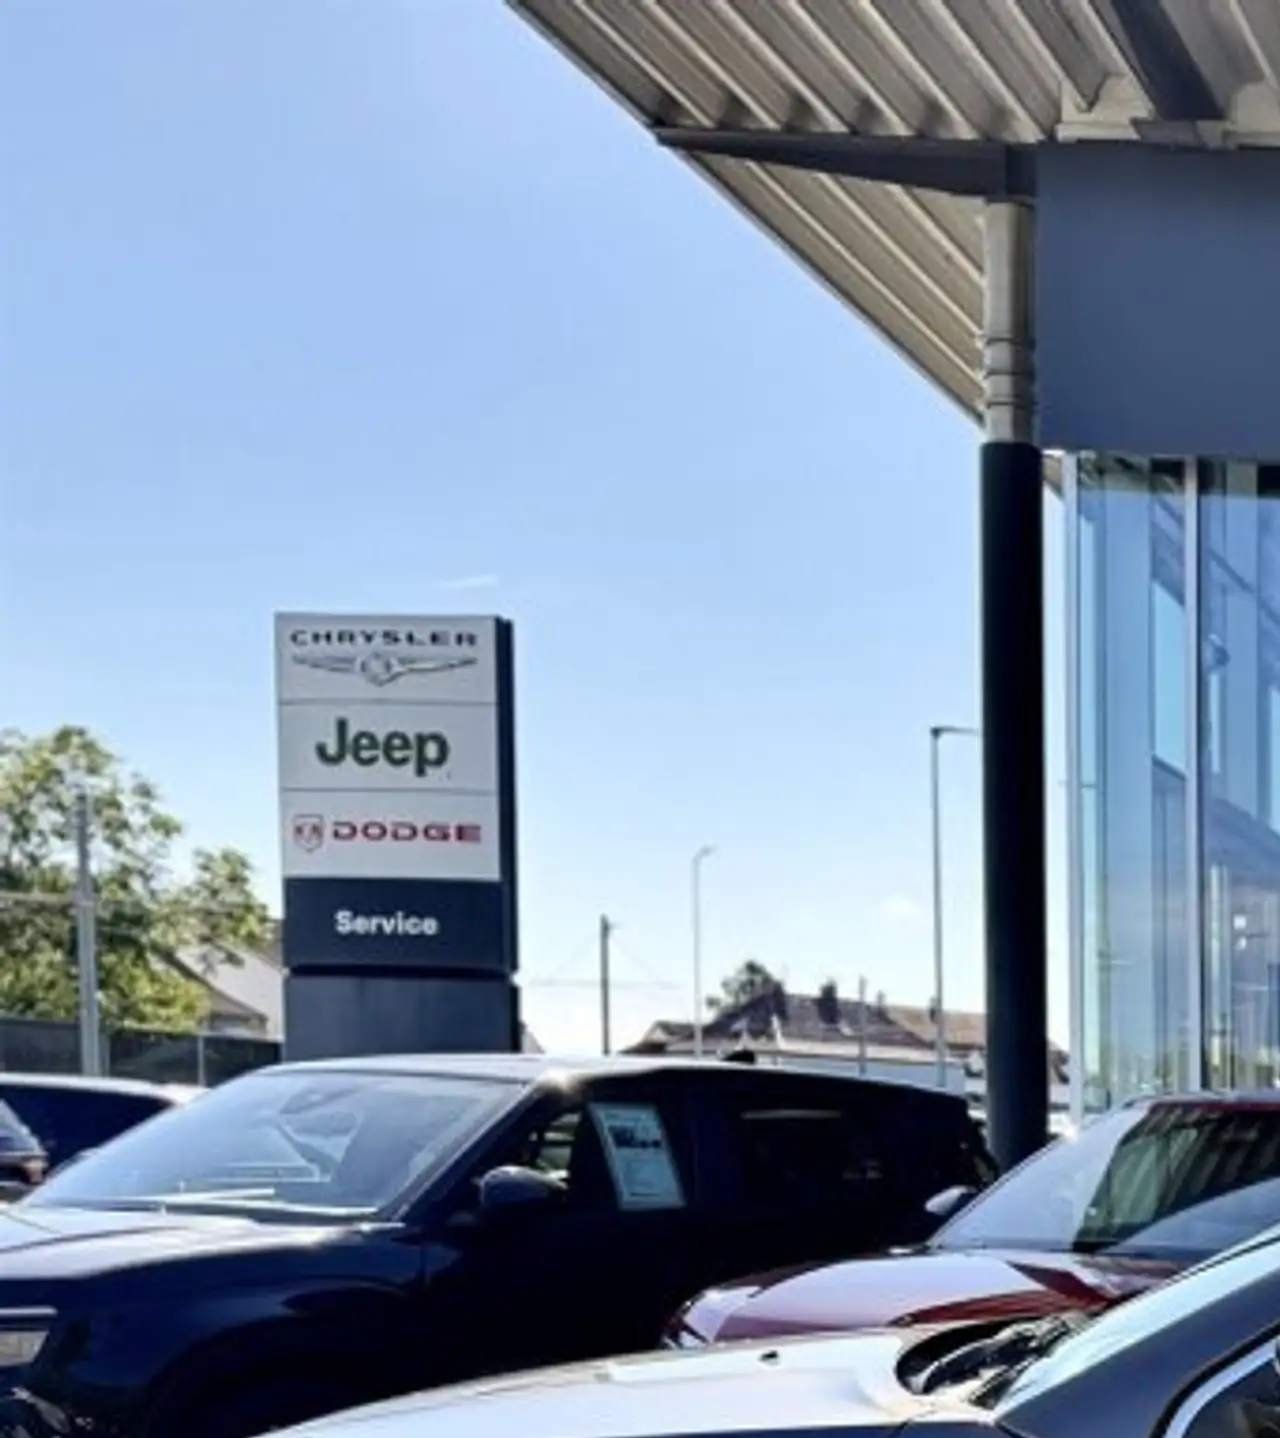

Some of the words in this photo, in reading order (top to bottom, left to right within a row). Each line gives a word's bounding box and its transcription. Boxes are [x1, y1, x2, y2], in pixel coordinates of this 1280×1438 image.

[290, 629, 478, 647] CHRYSLER
[315, 716, 450, 778] Jeep
[333, 821, 482, 842] DODGE
[335, 910, 439, 936] Service
